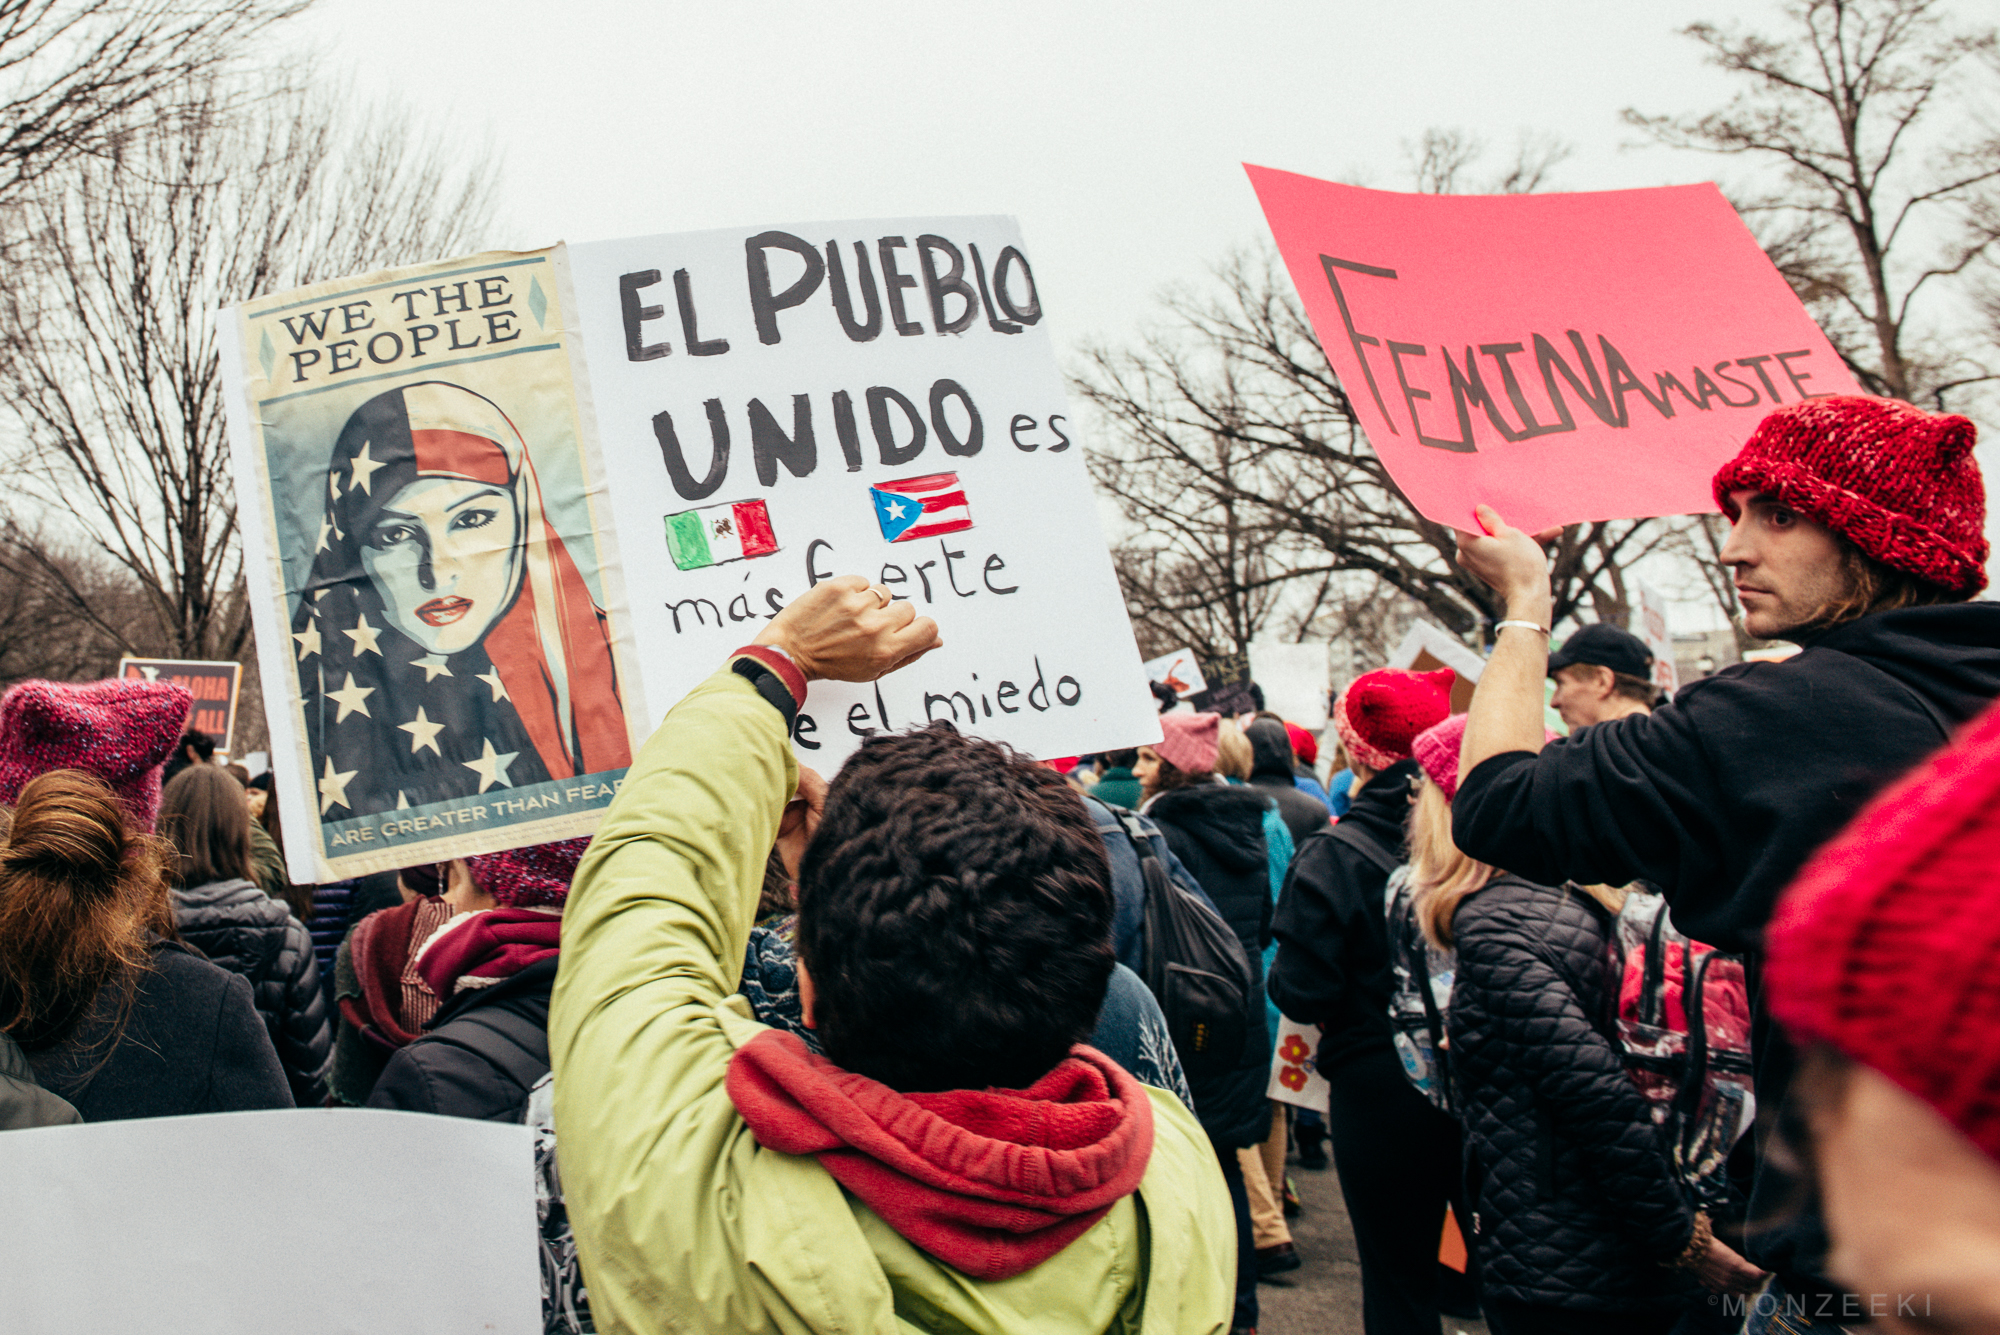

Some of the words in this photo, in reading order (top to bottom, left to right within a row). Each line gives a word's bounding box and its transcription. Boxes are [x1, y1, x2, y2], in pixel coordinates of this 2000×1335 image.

[279, 300, 375, 346] WE
[392, 275, 514, 321] THE
[619, 268, 731, 362] EL
[745, 230, 1044, 346] PUEBLO
[288, 310, 522, 384] PEOPLE
[652, 378, 985, 501] UNIDO
[1010, 412, 1072, 453] es
[665, 571, 785, 634] más
[806, 538, 1019, 604] ferte
[172, 675, 229, 702] OHA
[847, 679, 893, 736] el
[924, 654, 1082, 724] miedo
[330, 826, 375, 848] ARE
[380, 805, 488, 837] GREATER
[491, 791, 560, 817] THAN
